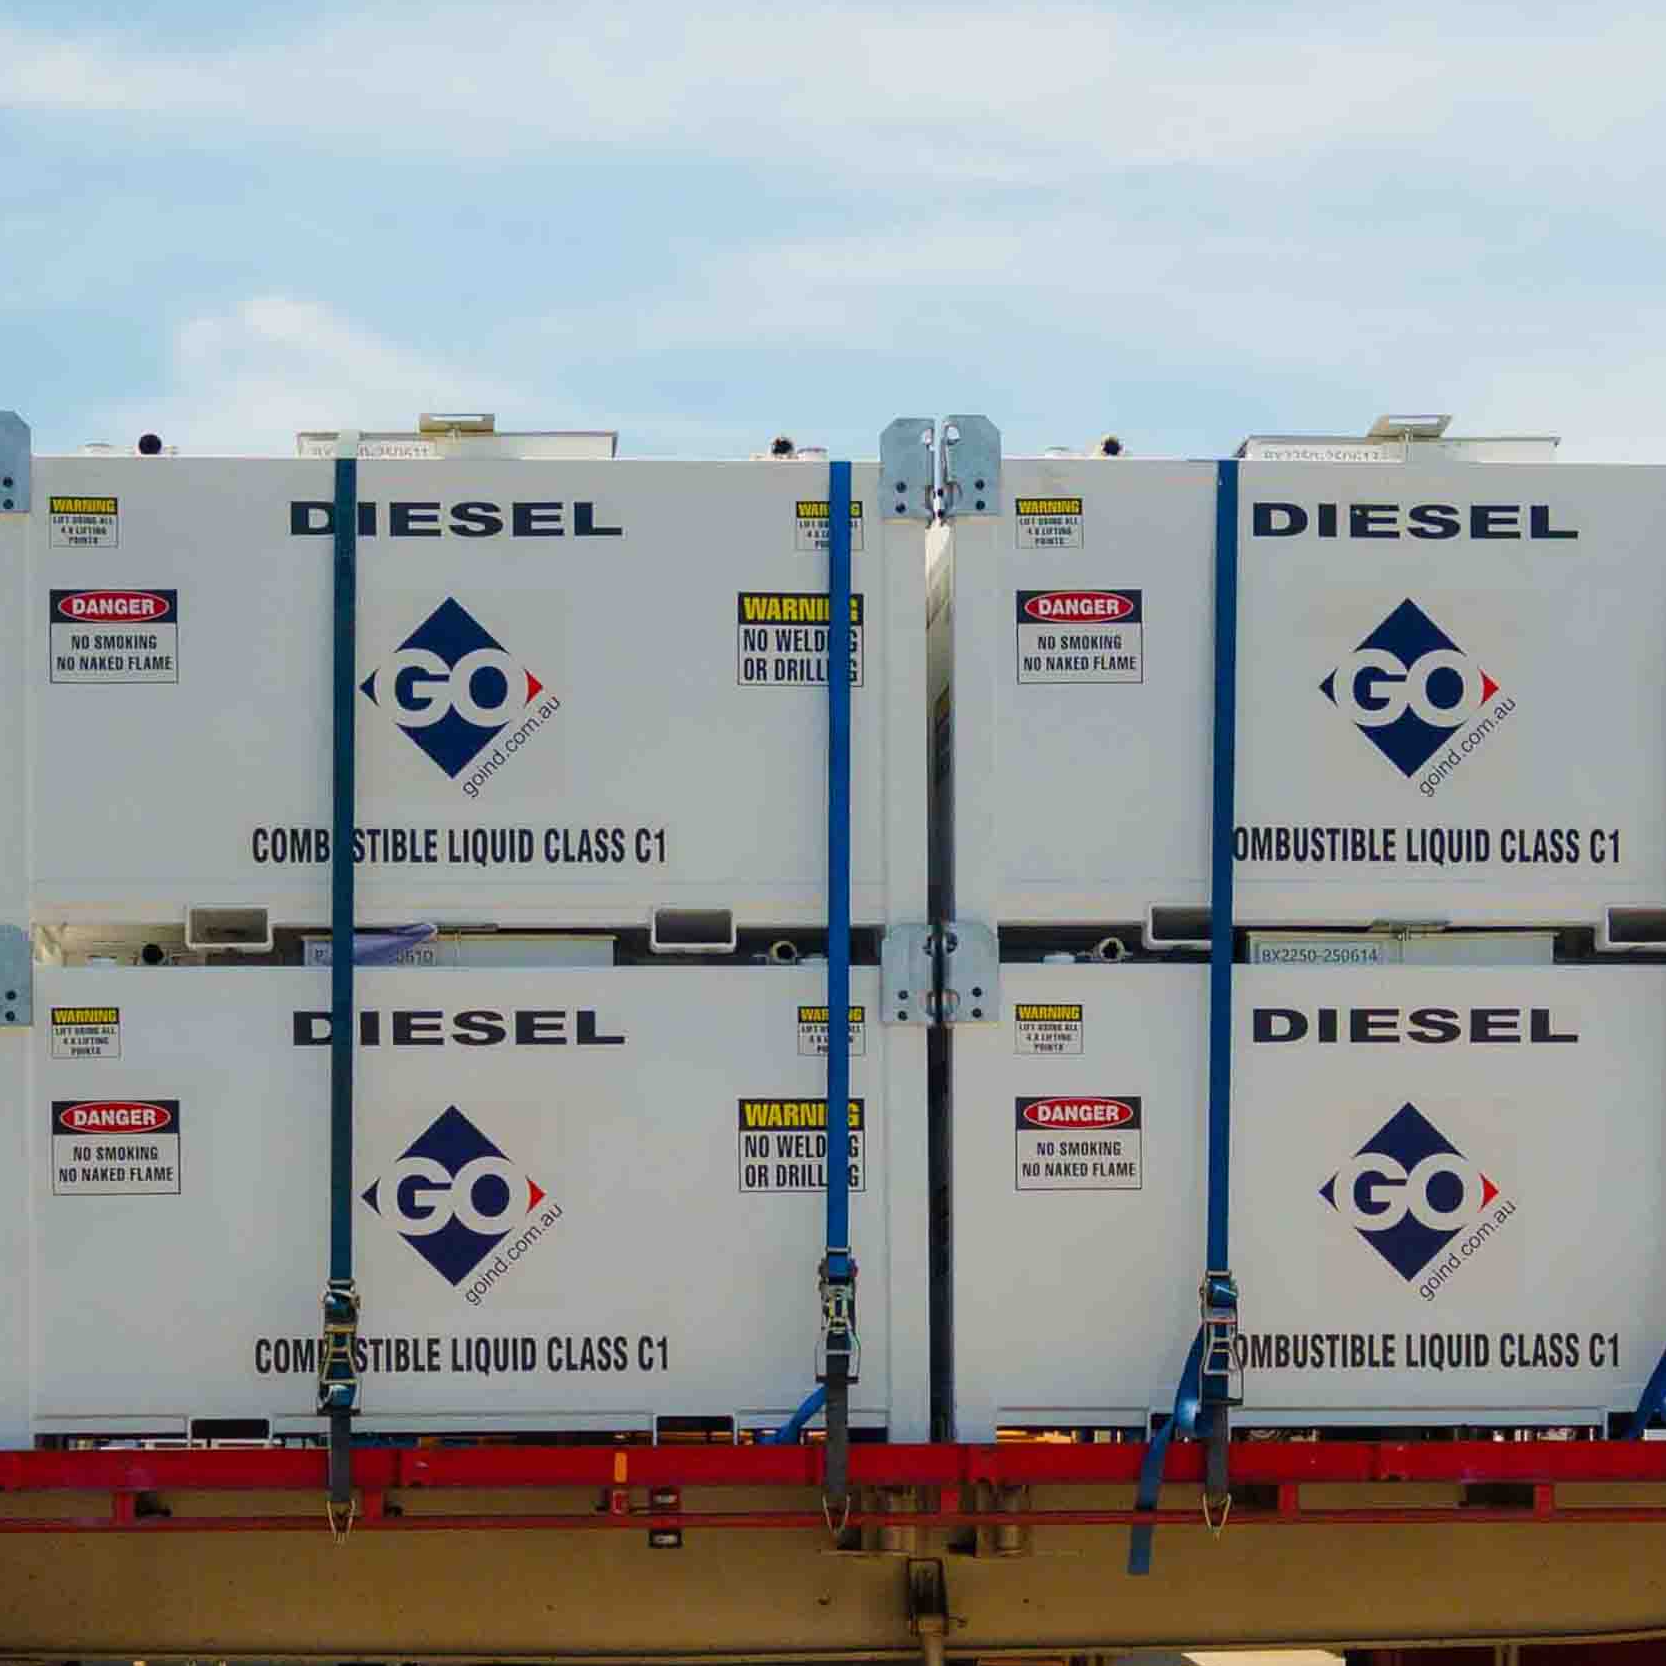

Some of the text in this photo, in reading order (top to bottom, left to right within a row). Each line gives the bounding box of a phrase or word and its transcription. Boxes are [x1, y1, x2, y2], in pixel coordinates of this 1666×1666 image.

[52, 499, 116, 513] WARNING
[1253, 503, 1578, 539] DIESEL
[71, 598, 156, 616] DANGER
[1038, 598, 1120, 616] DANGER
[72, 635, 157, 649] NO SMOKING
[1038, 635, 1121, 650] NO SMOKING
[57, 656, 171, 670] NO NAKED FLAME
[1024, 656, 1136, 671] NO NAKED FLAME
[377, 648, 527, 728] GO
[1336, 648, 1482, 727] GO
[462, 694, 562, 798] goind.com.au
[1419, 695, 1517, 798] goind.com.au
[253, 828, 664, 866] COMBSTIBLE LIQUID CLASS C1
[1234, 827, 1619, 865] OMBUSTIBLE LIQUID CLASS C1
[1262, 947, 1379, 965] BX2250-250614
[1253, 1009, 1578, 1043] DIESEL
[73, 1109, 158, 1127] DANGER
[1036, 1103, 1120, 1123] DANGER
[379, 1156, 527, 1235] GO
[1336, 1152, 1482, 1231] GO
[464, 1203, 564, 1306] goind.com.au
[1419, 1198, 1517, 1302] goind.com.au
[256, 1336, 667, 1375] COMSTIBLE LIQUID CLASS C1
[1237, 1333, 1619, 1371] OMBUSTIBLE LIQUID CLASS C1
